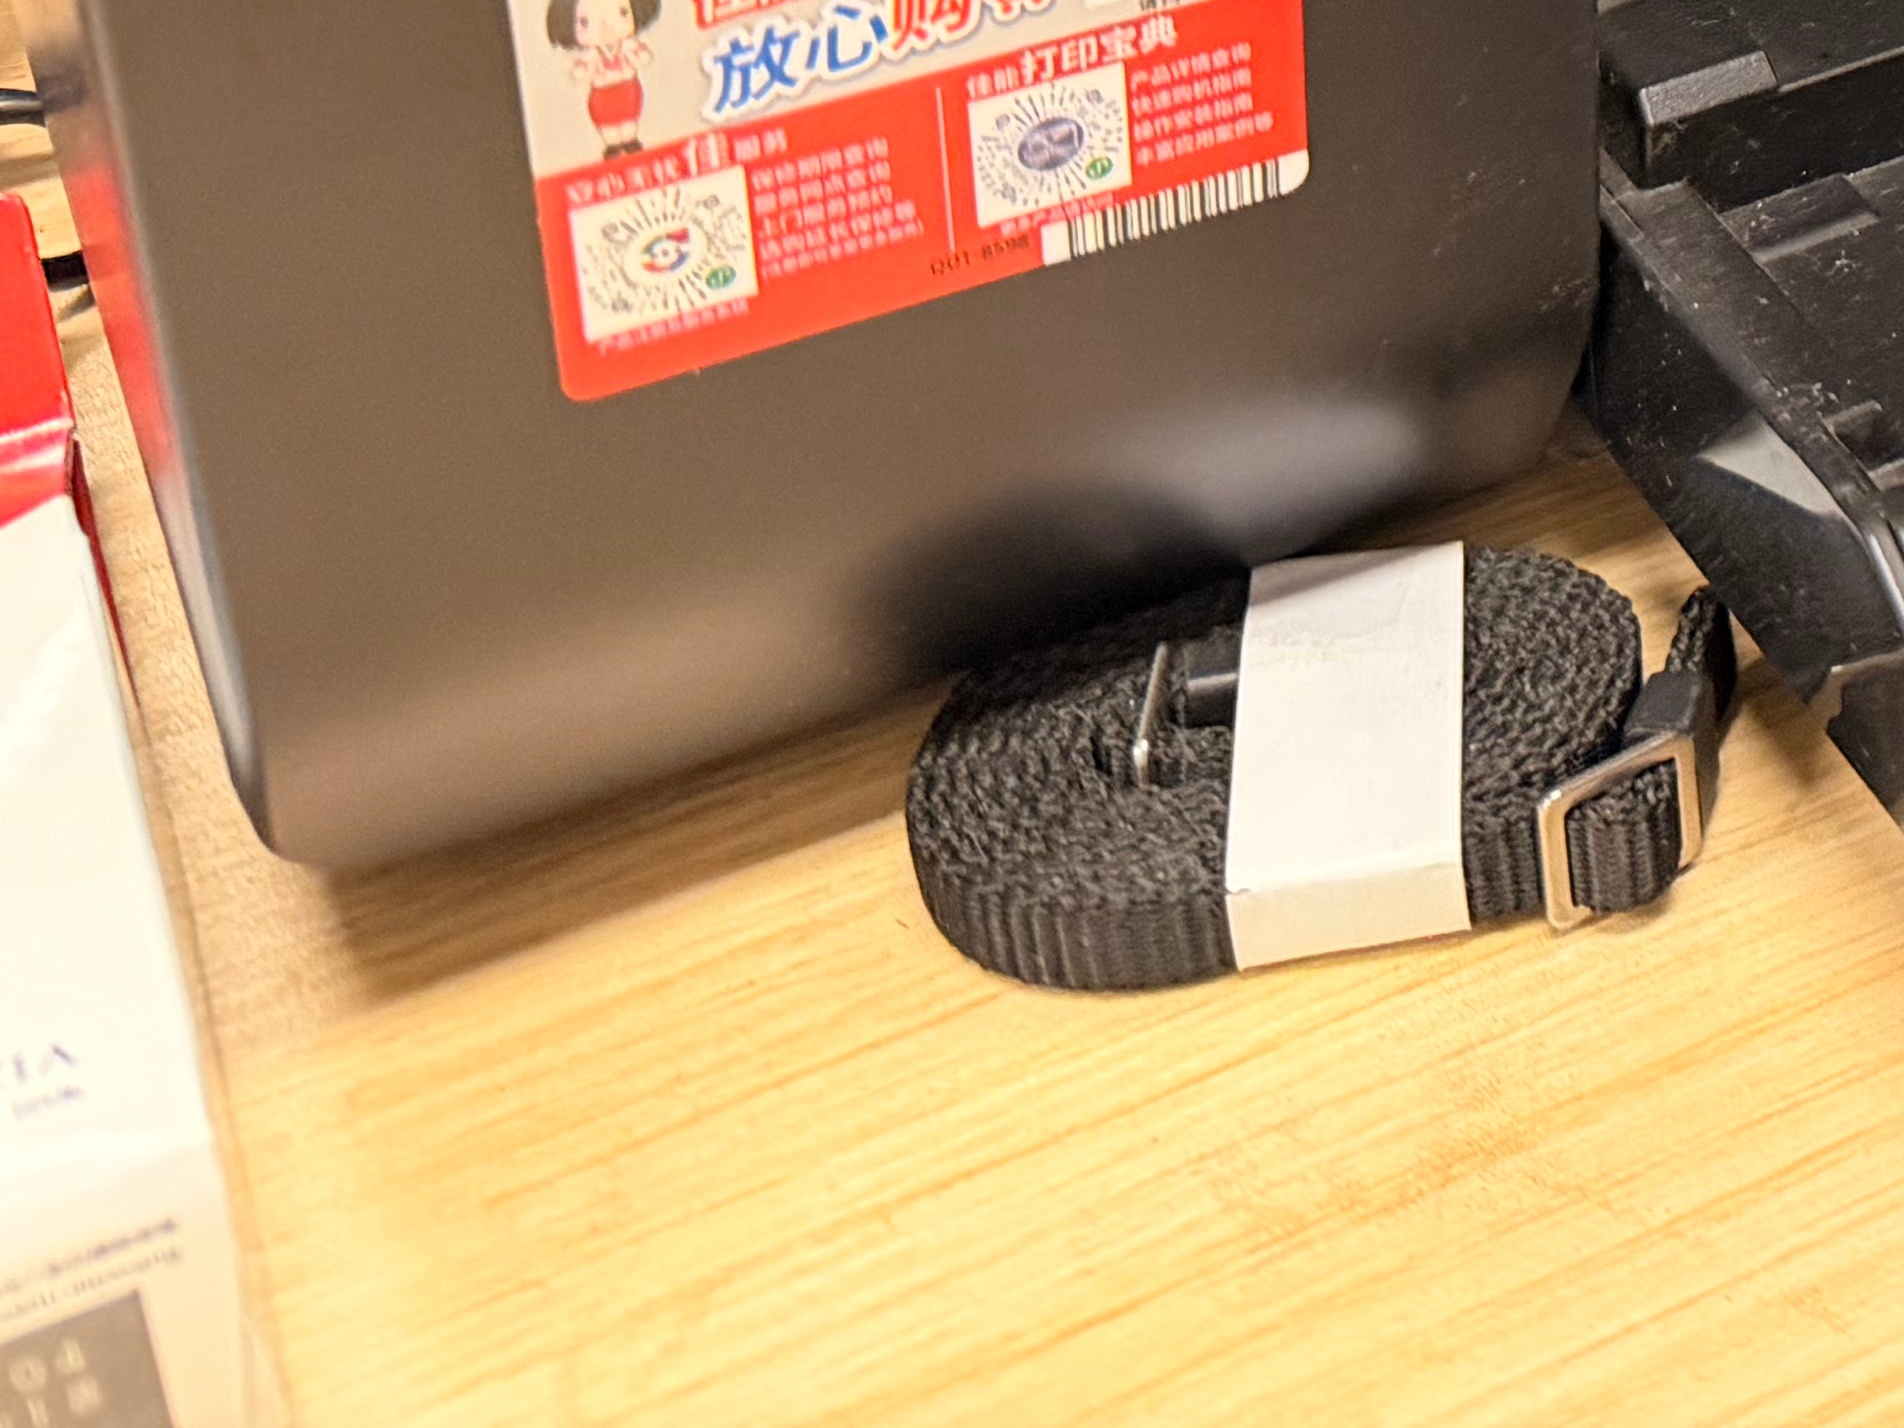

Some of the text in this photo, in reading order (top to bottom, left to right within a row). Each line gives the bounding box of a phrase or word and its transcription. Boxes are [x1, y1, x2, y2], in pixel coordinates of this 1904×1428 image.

[966, 14, 1178, 99] 佳能打印宝典
